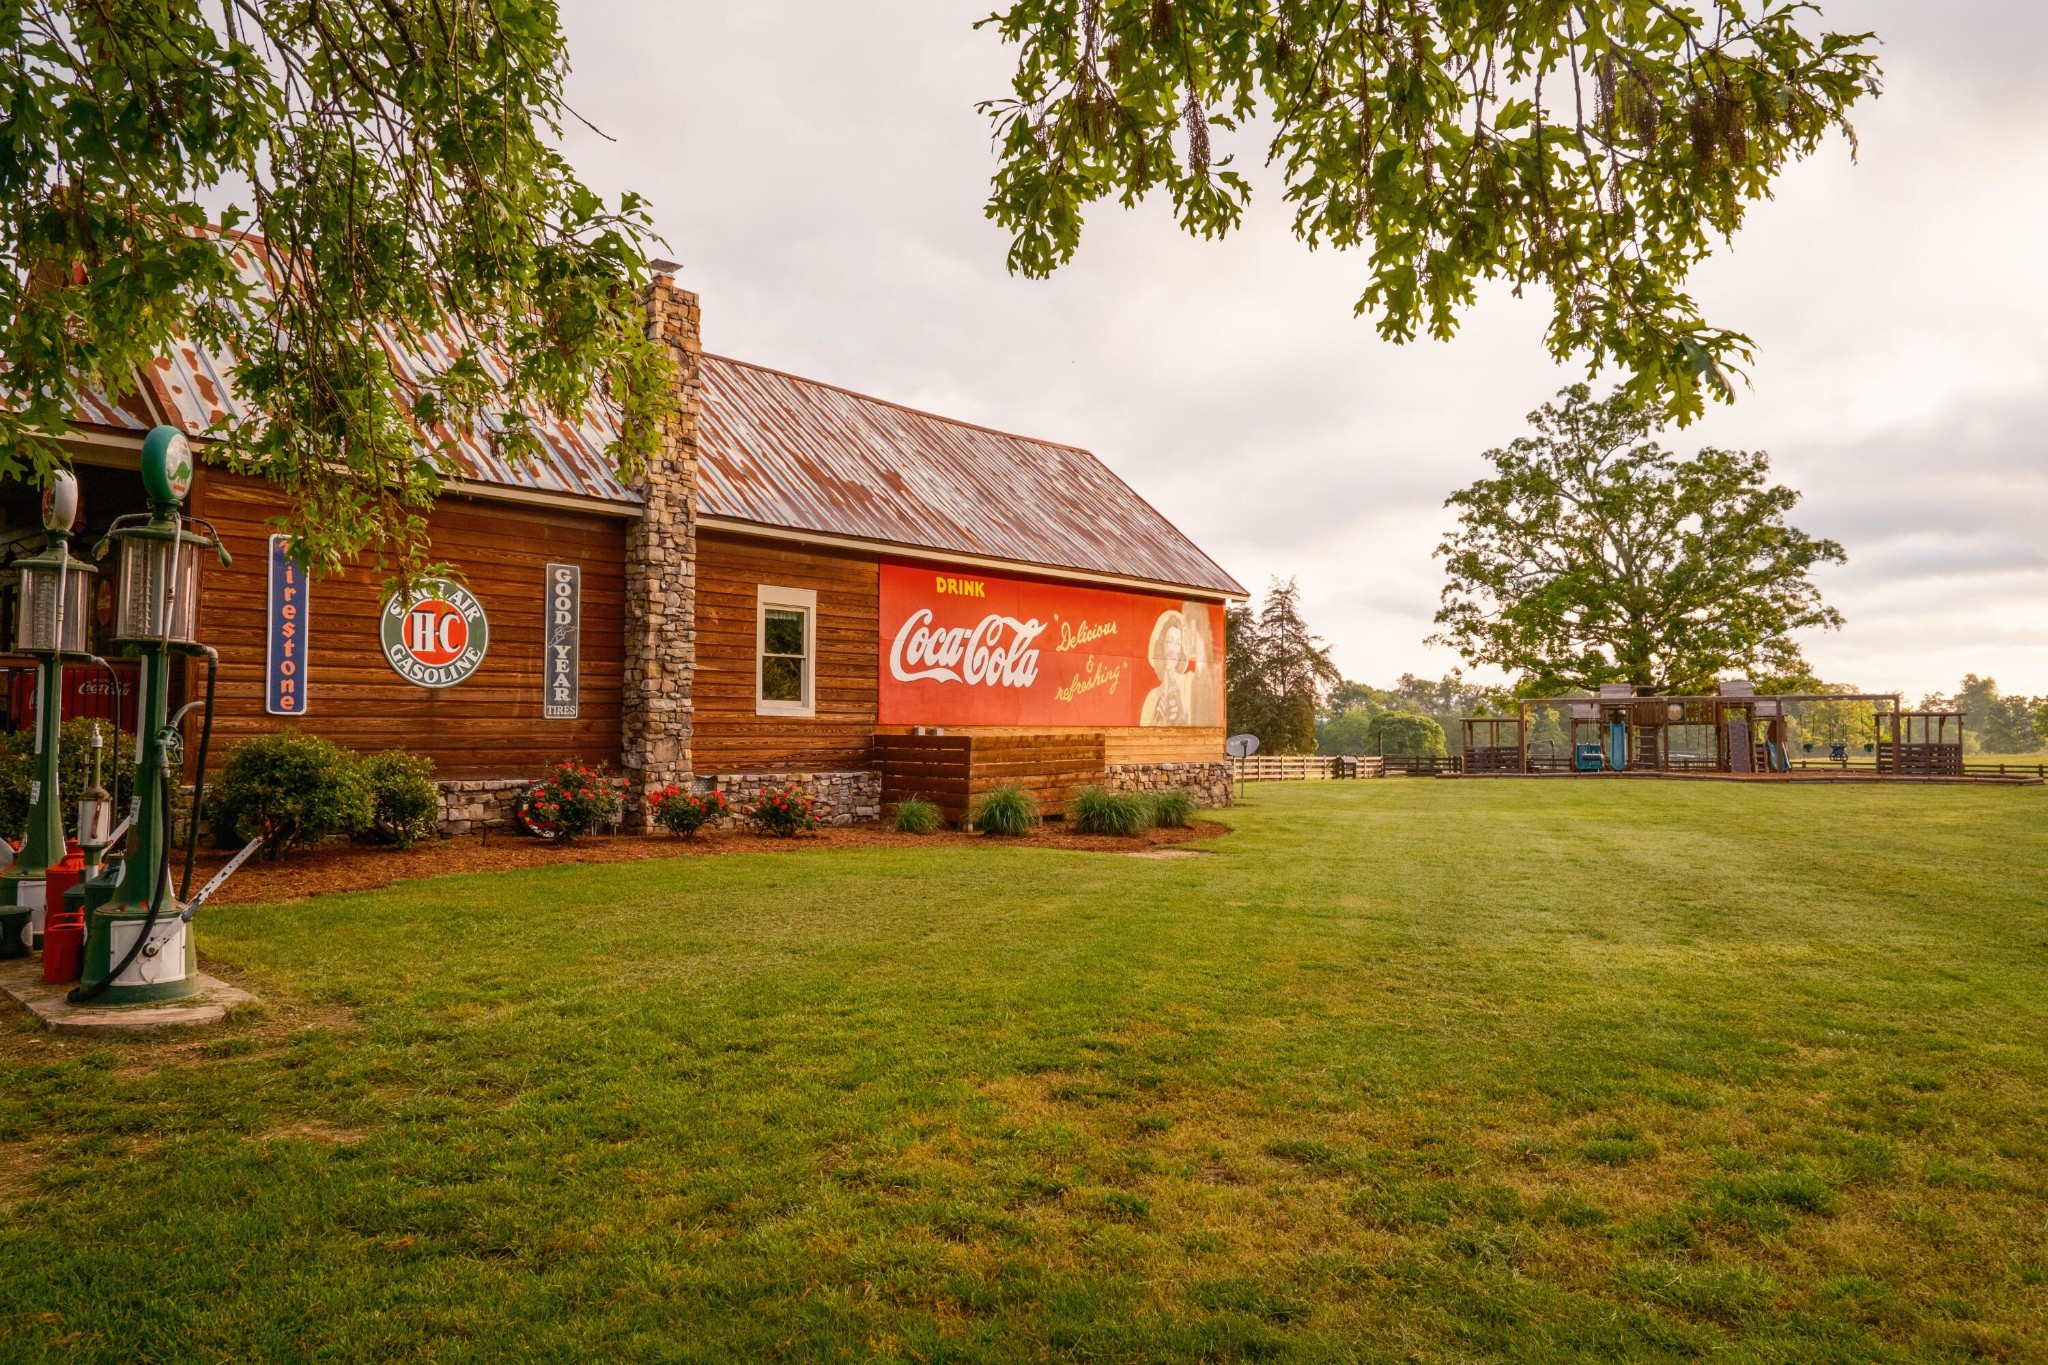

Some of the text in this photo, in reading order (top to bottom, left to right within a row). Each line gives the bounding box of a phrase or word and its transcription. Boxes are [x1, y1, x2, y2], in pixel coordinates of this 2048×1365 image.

[935, 576, 985, 598] DRINK
[889, 608, 1048, 688] Coca-Cola
[390, 643, 481, 683] GASOLINE
[1085, 654, 1095, 673] &
[547, 705, 576, 715] TIRES
